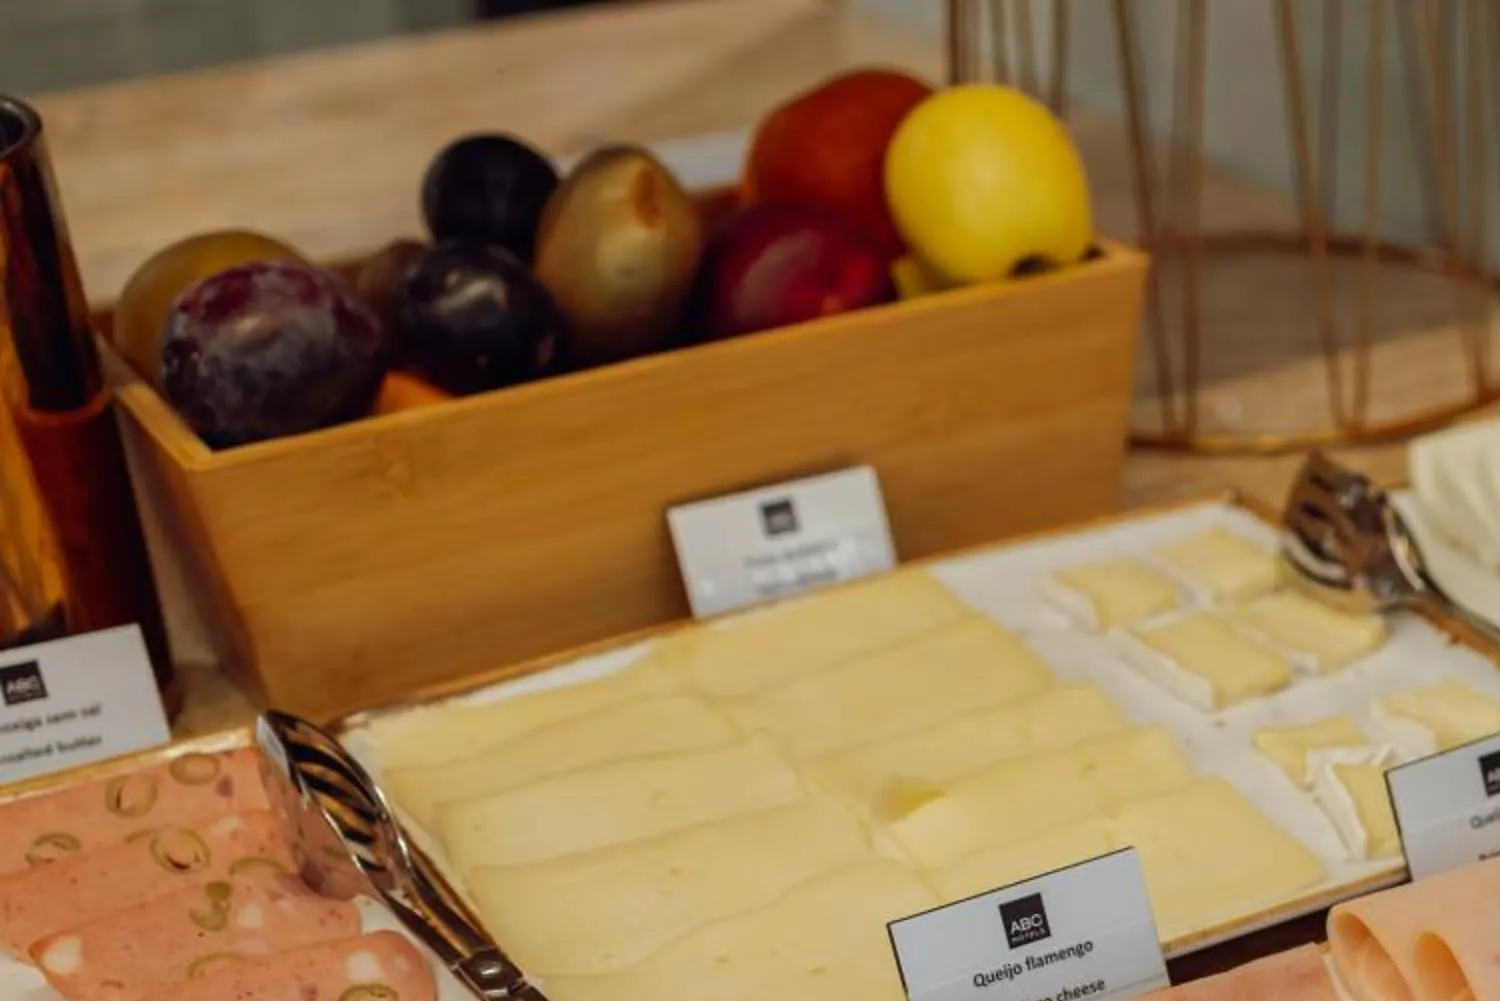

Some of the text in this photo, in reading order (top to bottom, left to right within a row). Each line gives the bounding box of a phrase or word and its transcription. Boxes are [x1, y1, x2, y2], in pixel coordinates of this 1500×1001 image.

[1010, 912, 1045, 936] ABC
[973, 940, 1093, 988] Queijo flamengo
